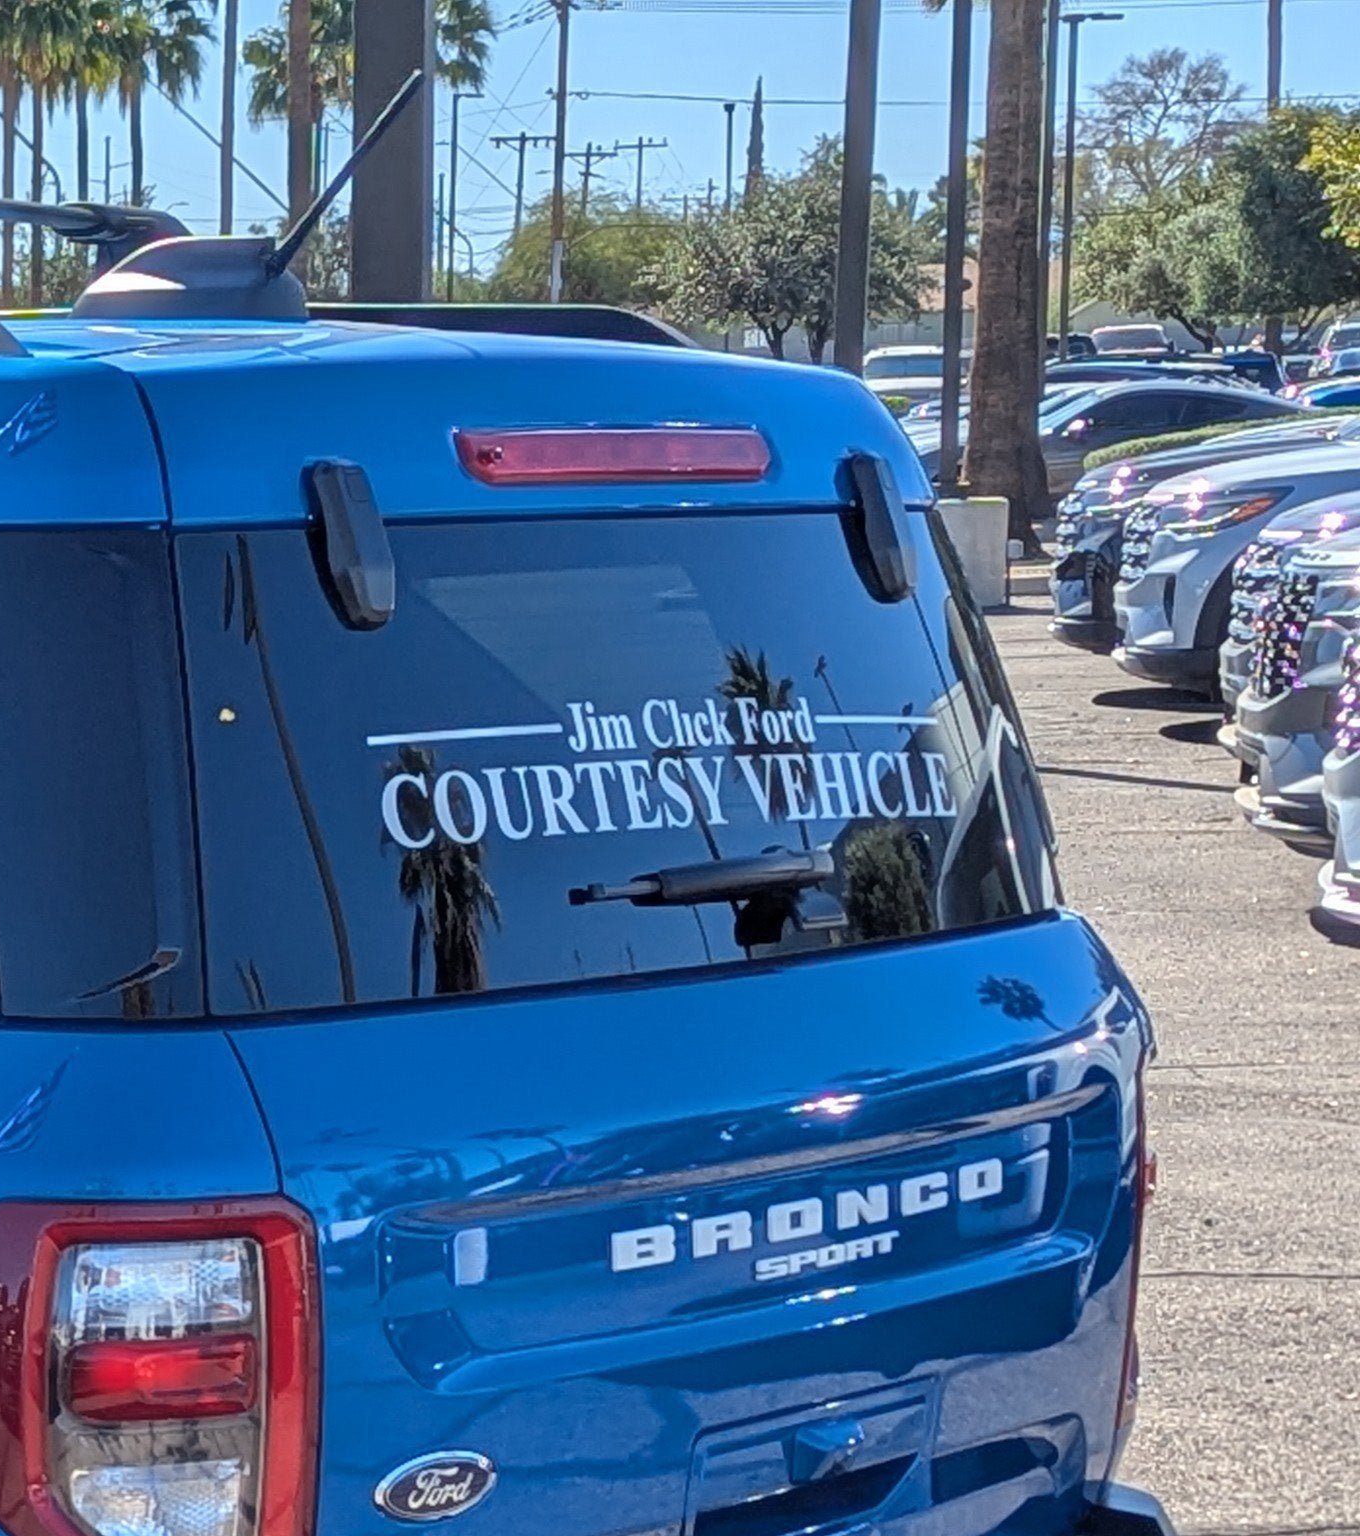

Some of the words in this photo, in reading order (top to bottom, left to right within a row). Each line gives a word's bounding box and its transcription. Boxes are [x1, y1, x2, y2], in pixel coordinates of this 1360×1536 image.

[566, 700, 638, 752] Jim
[642, 698, 736, 749] Click
[734, 696, 818, 746] Ford
[380, 753, 726, 851] COURTESY
[736, 750, 959, 824] VEHICLE
[611, 1157, 1004, 1273] BRONCO
[755, 1230, 901, 1282] SPORT
[407, 1465, 476, 1510] Ford
